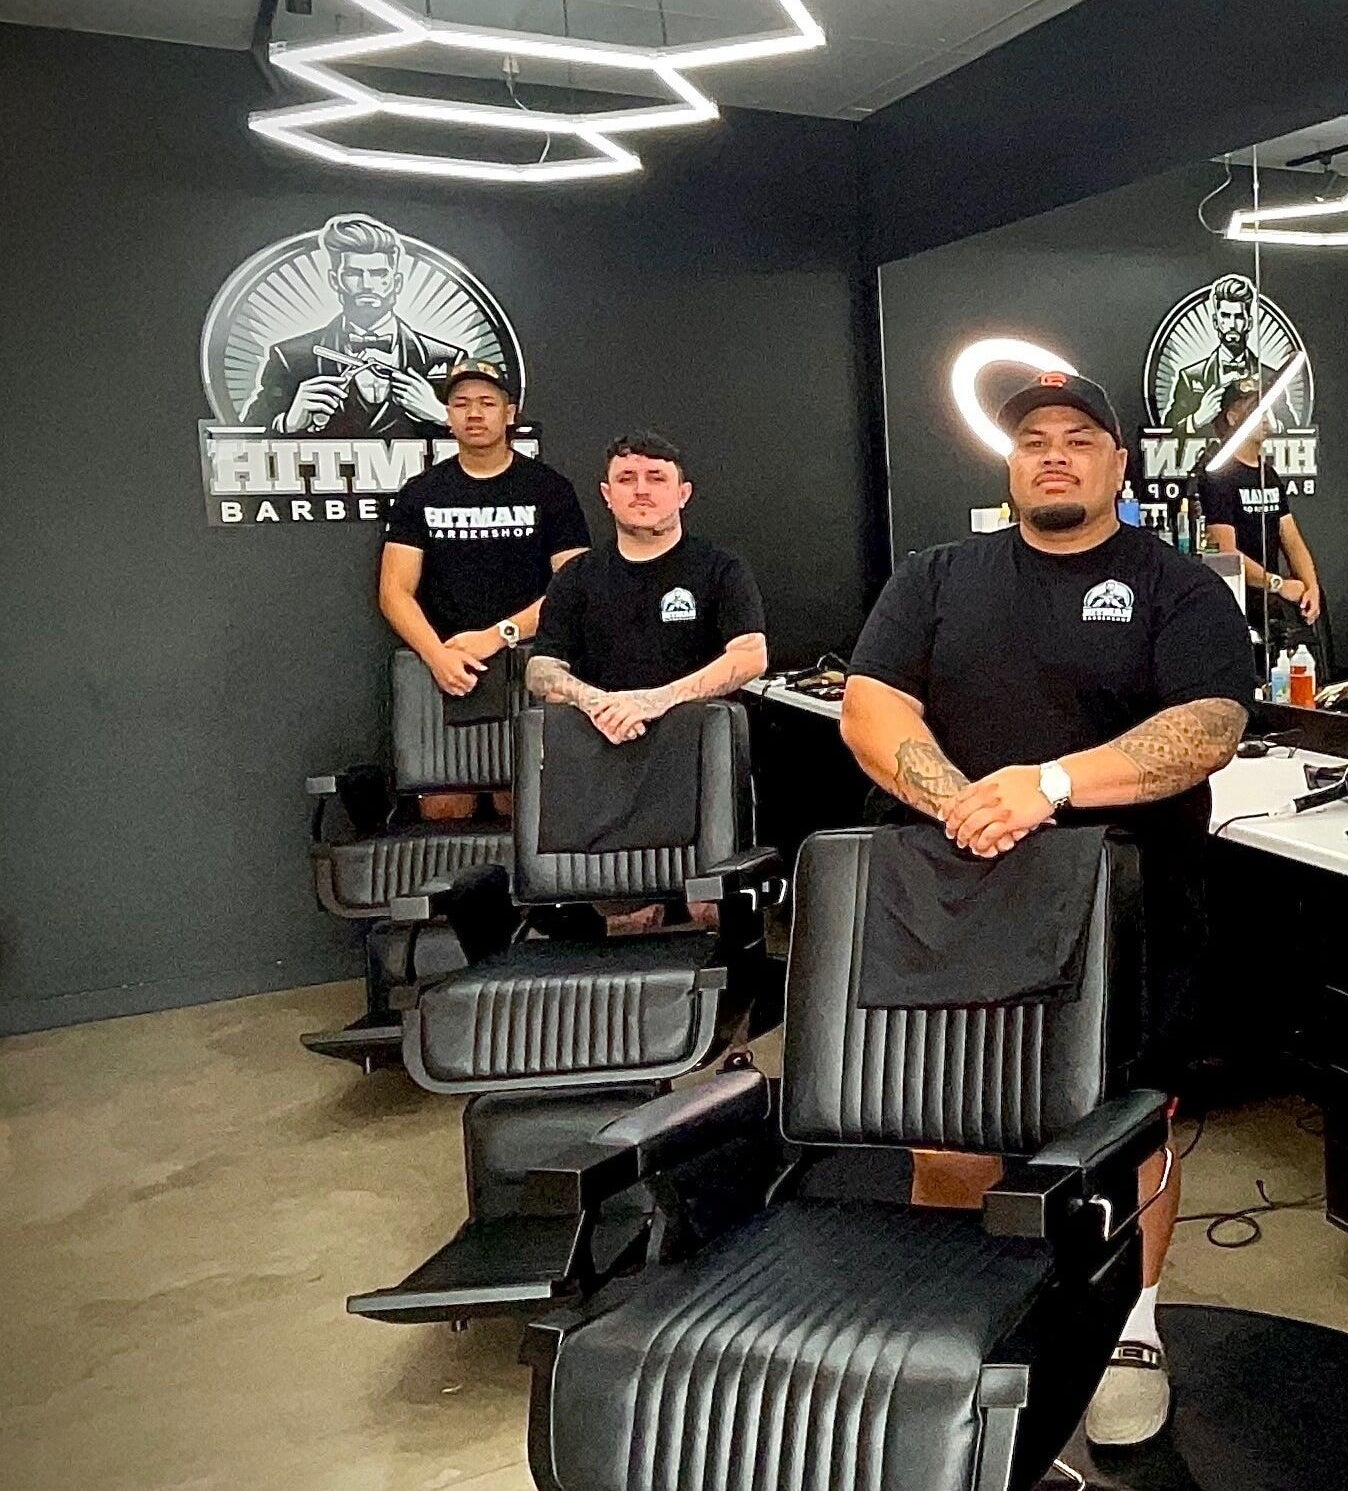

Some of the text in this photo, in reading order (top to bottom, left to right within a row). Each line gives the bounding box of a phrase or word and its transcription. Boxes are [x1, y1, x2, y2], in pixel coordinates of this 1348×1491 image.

[207, 438, 539, 495] HITM
[220, 498, 395, 523] BARBE
[424, 505, 537, 529] HITMAN
